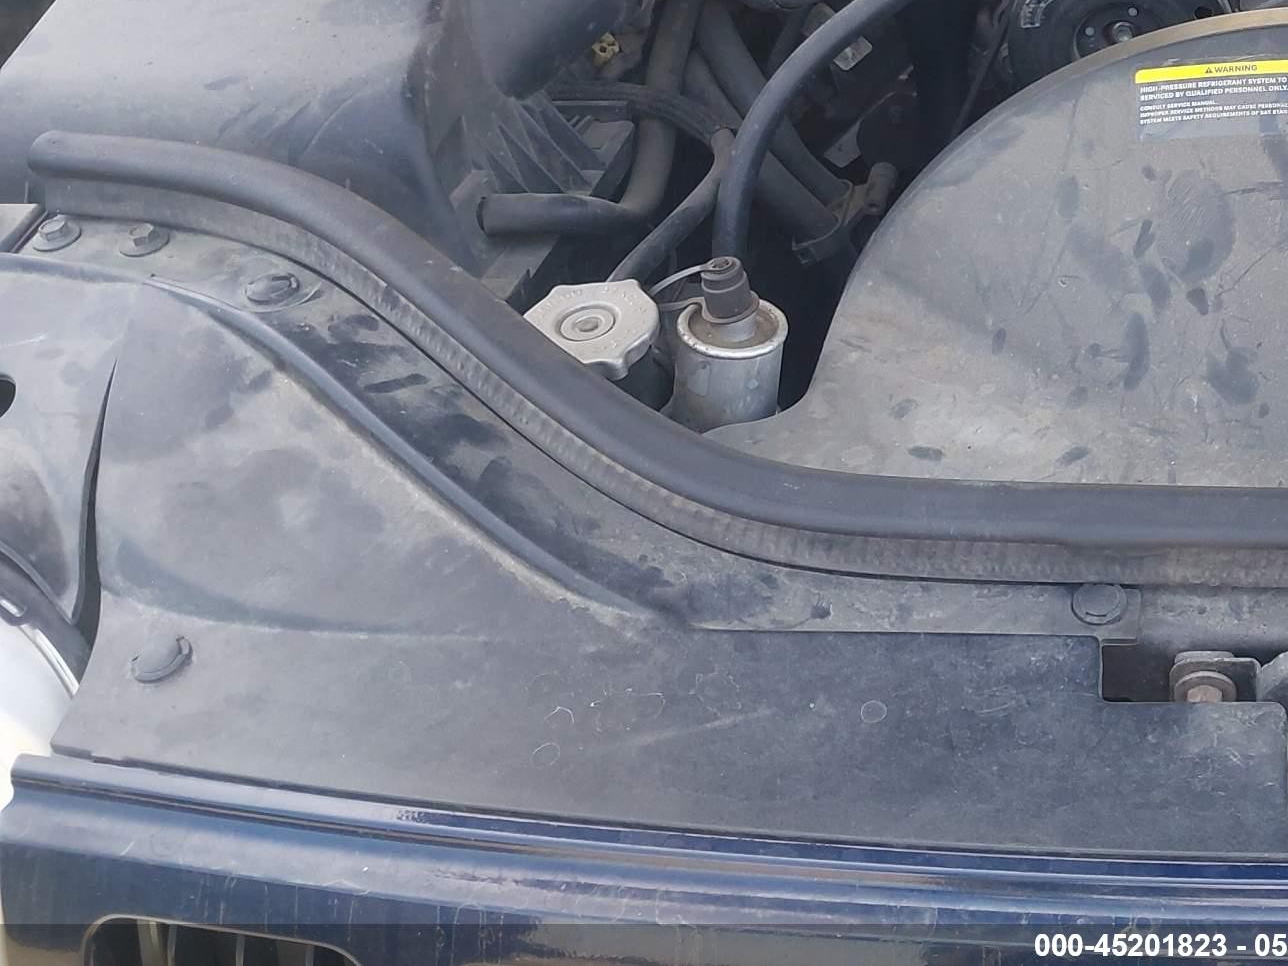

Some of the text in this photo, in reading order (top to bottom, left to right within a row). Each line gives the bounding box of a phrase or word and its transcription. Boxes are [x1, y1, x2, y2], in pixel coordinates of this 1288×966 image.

[1214, 64, 1258, 73] WARNING
[1140, 82, 1197, 93] HIGH-PRESSURE
[1198, 79, 1246, 88] REFRIGERANT
[1248, 77, 1276, 85] SYSTEM
[1140, 92, 1174, 101] SERVICED
[1185, 88, 1223, 97] QUALIFIED
[1225, 85, 1266, 94] PERSONNEL
